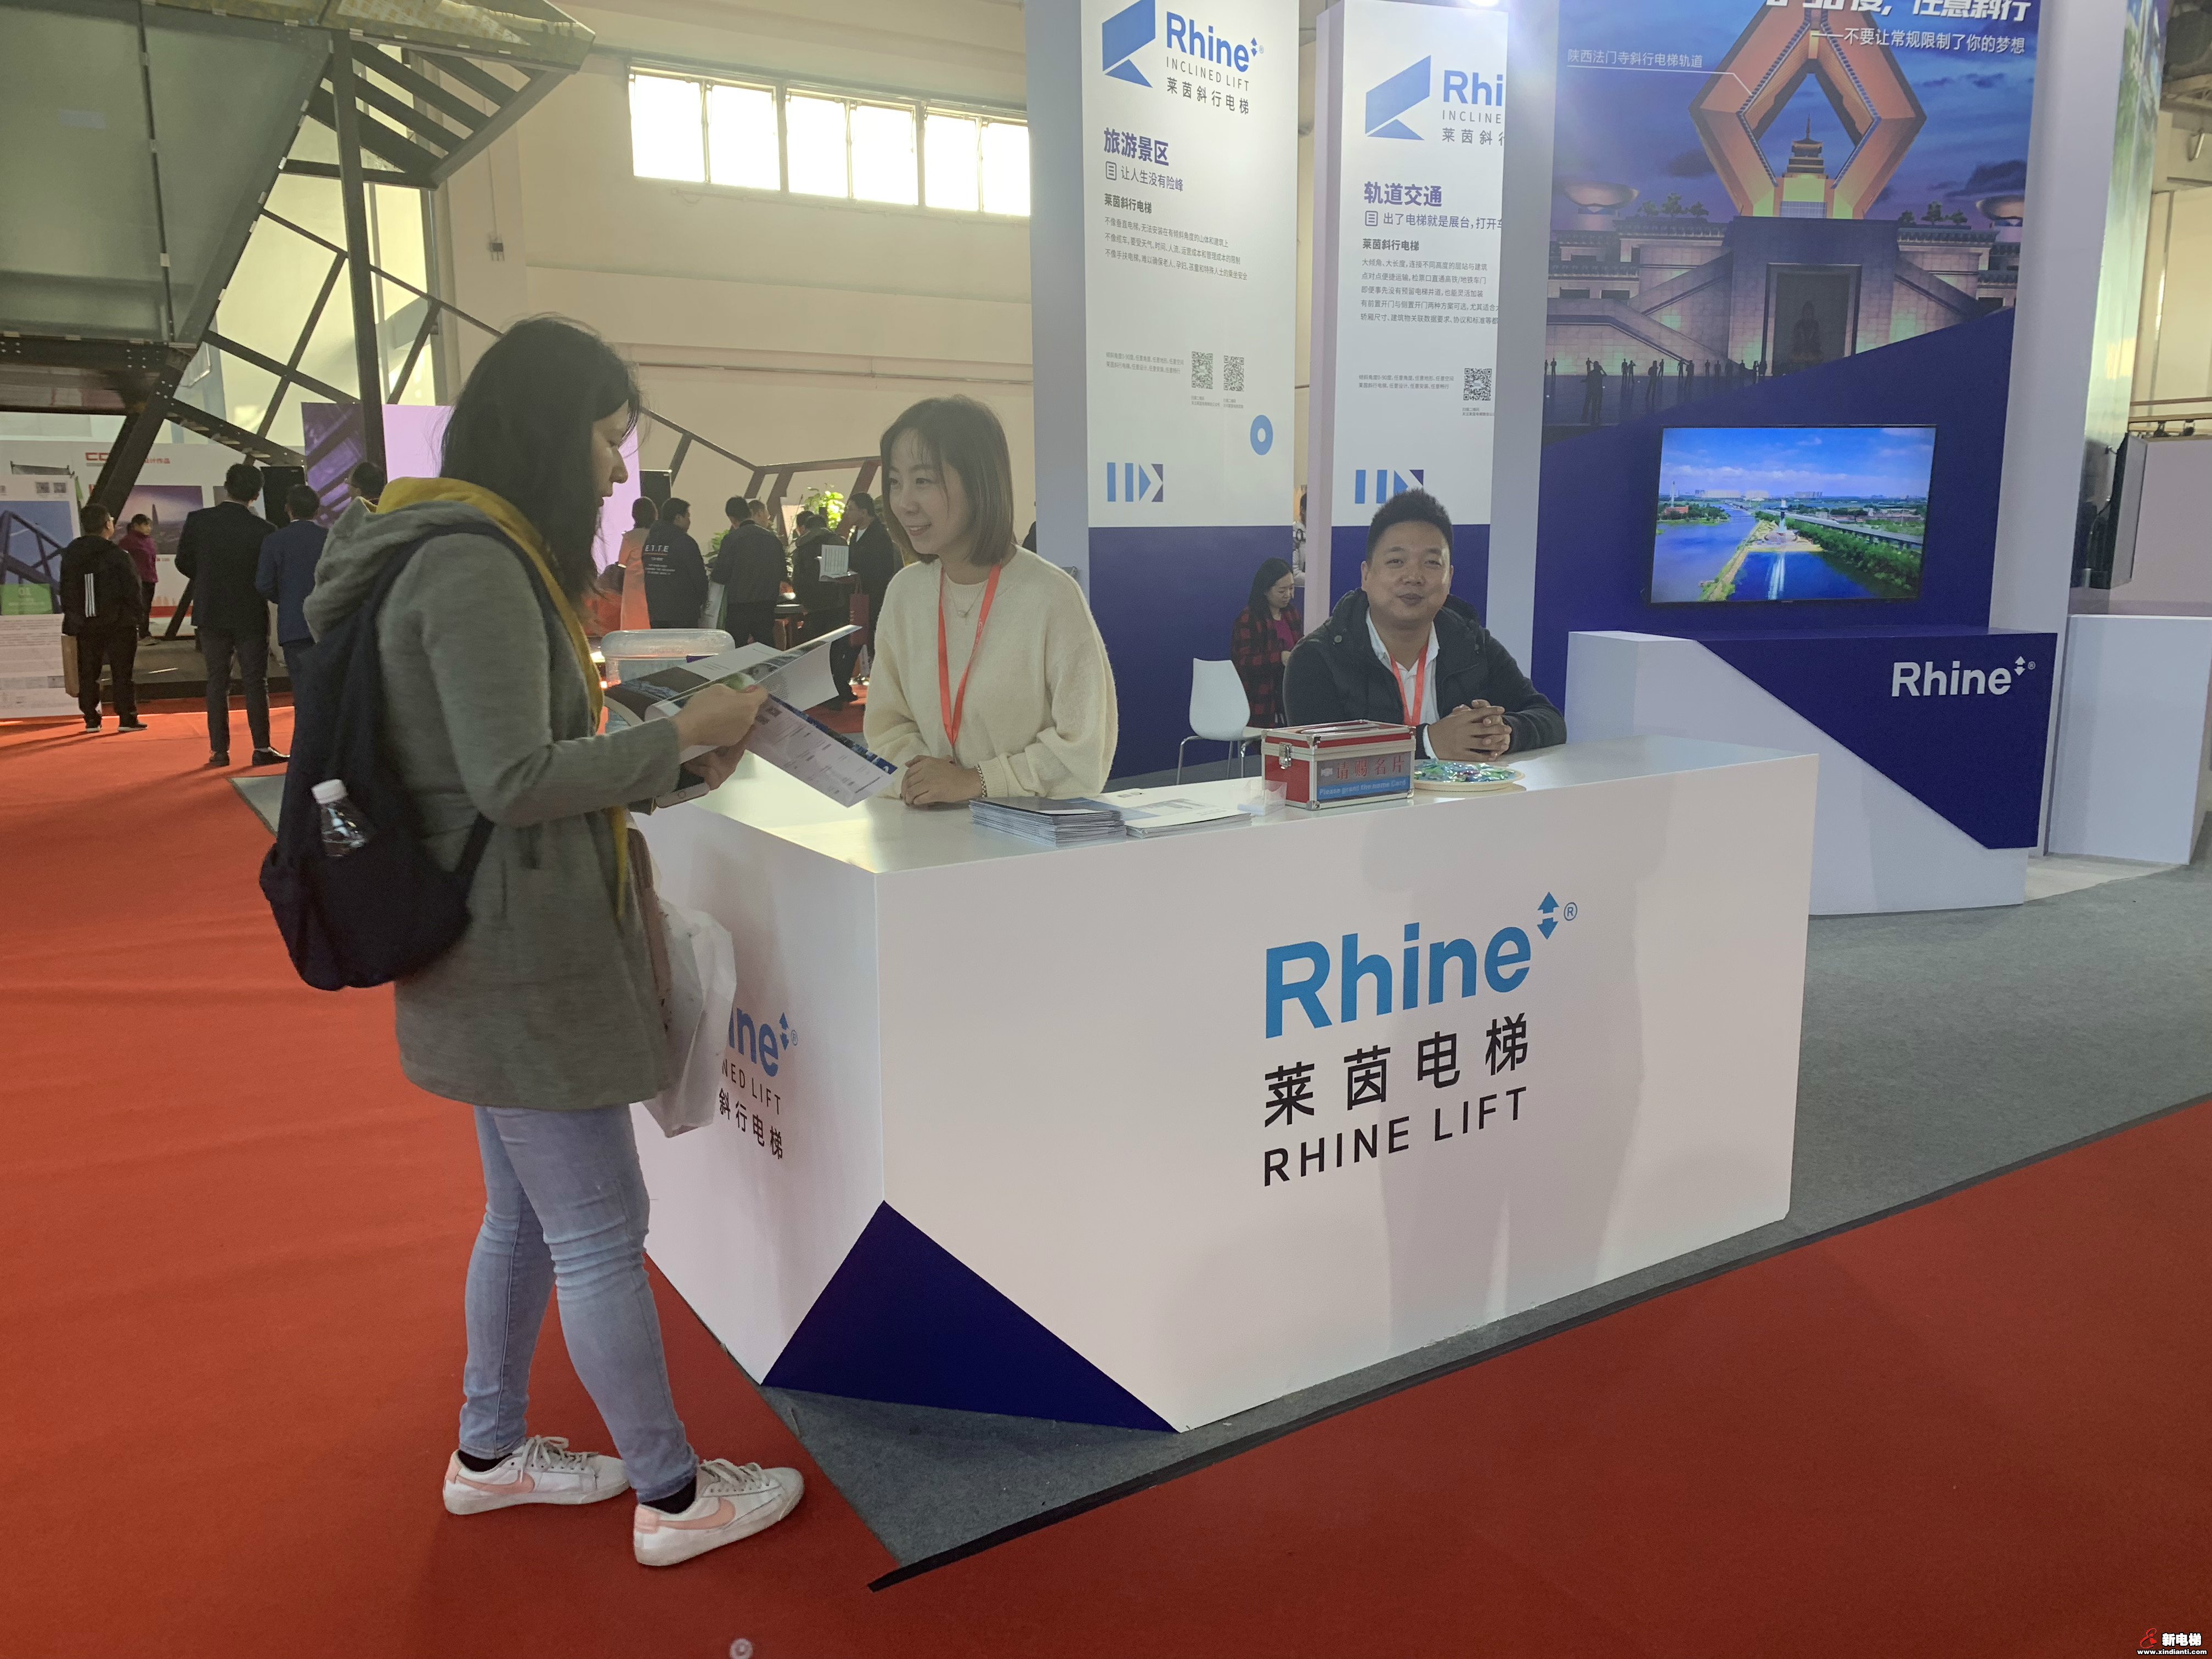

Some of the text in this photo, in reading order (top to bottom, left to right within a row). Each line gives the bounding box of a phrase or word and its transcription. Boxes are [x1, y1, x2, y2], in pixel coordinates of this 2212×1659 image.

[1166, 11, 1249, 72] Rhine
[1567, 49, 1703, 68] 陕西法门寺斜行电梯轨道
[1166, 57, 1249, 92] INCLINED LIFT
[1443, 70, 1503, 106] Rhi
[1167, 77, 1249, 115] 莱茵斜行电梯
[1104, 127, 1170, 166] 旅游景区
[1121, 165, 1183, 192] 让人生没有险峰
[1364, 181, 1442, 207] 轨道交通
[1104, 193, 1152, 215] 莱茵斜行电梯
[1363, 238, 1419, 251] 莱茵斜行电梯
[1892, 661, 2012, 697] Rhine
[1337, 755, 1404, 780] 请赐名片
[1266, 922, 1531, 1039] Rhine
[1265, 1013, 1528, 1128] 莱茵电梯
[752, 1077, 781, 1115] LIFT
[719, 1087, 783, 1160] 斜行电梯
[1265, 1086, 1527, 1187] RHINE LIFT
